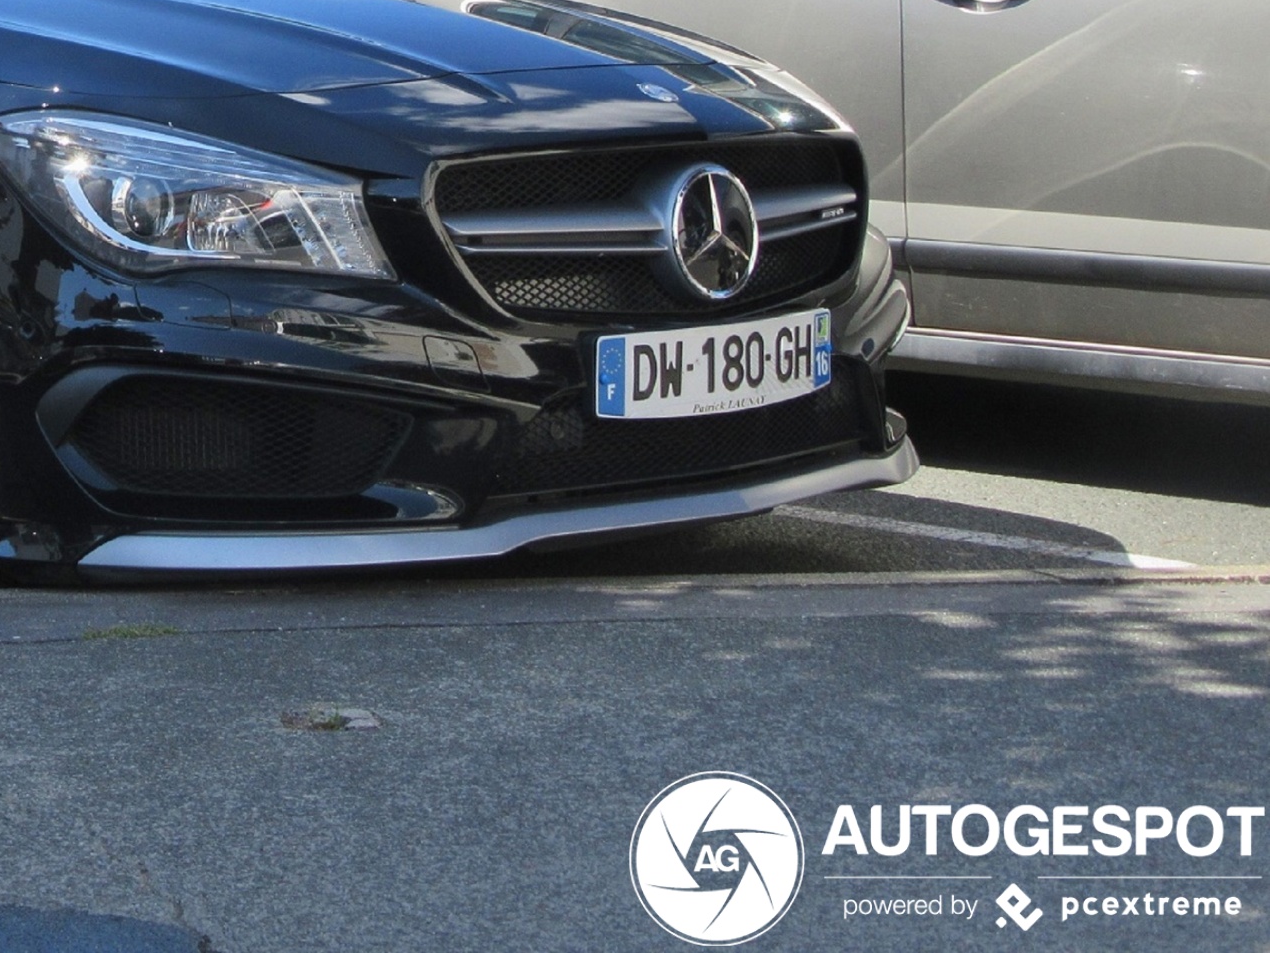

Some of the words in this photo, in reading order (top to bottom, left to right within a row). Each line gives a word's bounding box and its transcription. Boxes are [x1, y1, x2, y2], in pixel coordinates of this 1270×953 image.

[633, 324, 812, 401] DW-180-GH
[816, 351, 828, 376] 16
[607, 383, 616, 400] F
